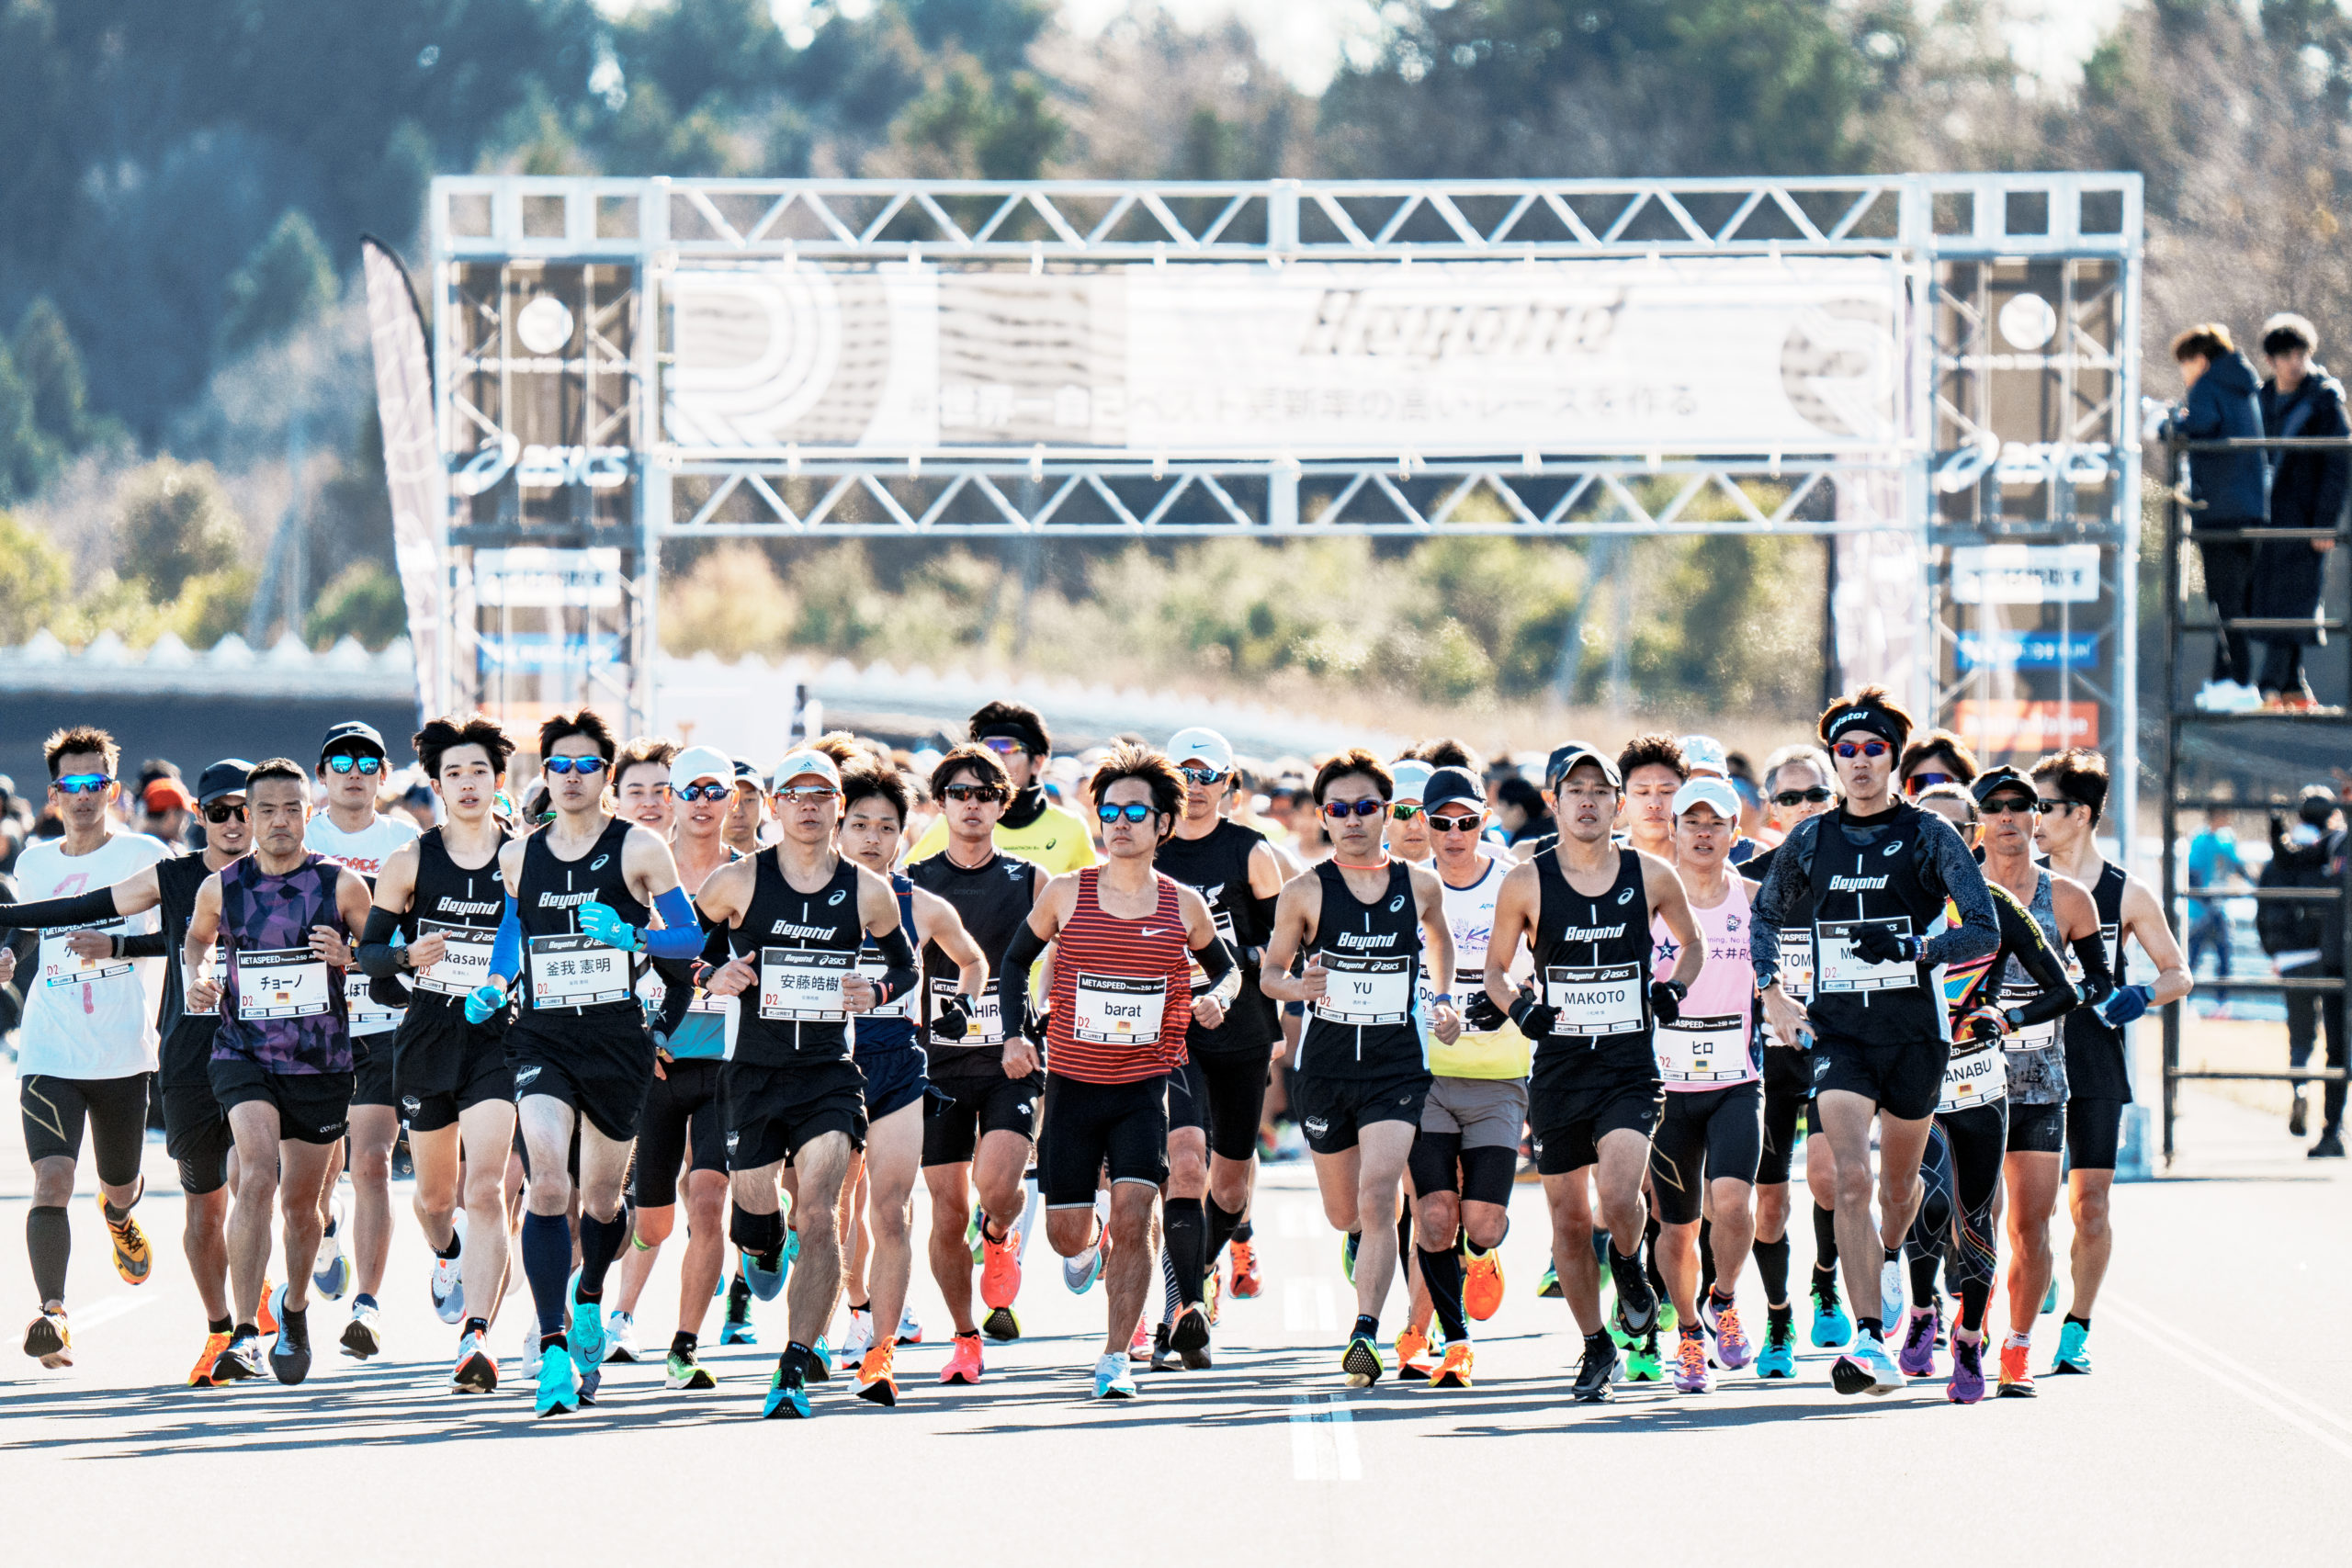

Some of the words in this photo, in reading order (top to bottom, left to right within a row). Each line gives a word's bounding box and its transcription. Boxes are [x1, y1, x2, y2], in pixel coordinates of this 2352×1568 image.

[1829, 874, 1890, 893] Beyond
[538, 888, 600, 909] Beyond
[436, 897, 501, 916] Beyond
[771, 919, 838, 941] Beyond
[1565, 922, 1626, 942] Beyond
[548, 940, 579, 950] Beyond
[1337, 931, 1398, 951] Beyond
[240, 956, 281, 965] METASPEED
[785, 953, 814, 963] Beyond
[828, 956, 847, 964] asics
[1337, 960, 1366, 969] Beyond
[1380, 962, 1399, 970] asics
[47, 964, 59, 976] D2
[419, 965, 431, 976] D2
[580, 957, 611, 974] 憲明
[1566, 972, 1596, 981] Beyond
[1611, 969, 1629, 978] asics
[1825, 967, 1837, 978] D2
[260, 975, 303, 991] チョーノ
[537, 983, 548, 995] D2
[1081, 978, 1126, 989] METASPEED
[1353, 981, 1373, 994] YU
[242, 996, 254, 1007] D2
[765, 993, 778, 1006] D2
[1320, 996, 1331, 1007] D2
[1565, 989, 1625, 1005] MAKOTO
[1104, 1001, 1141, 1018] barat
[1078, 1016, 1091, 1028] D2
[1692, 1040, 1713, 1055] ヒロ
[1943, 1058, 1993, 1084] ANABU
